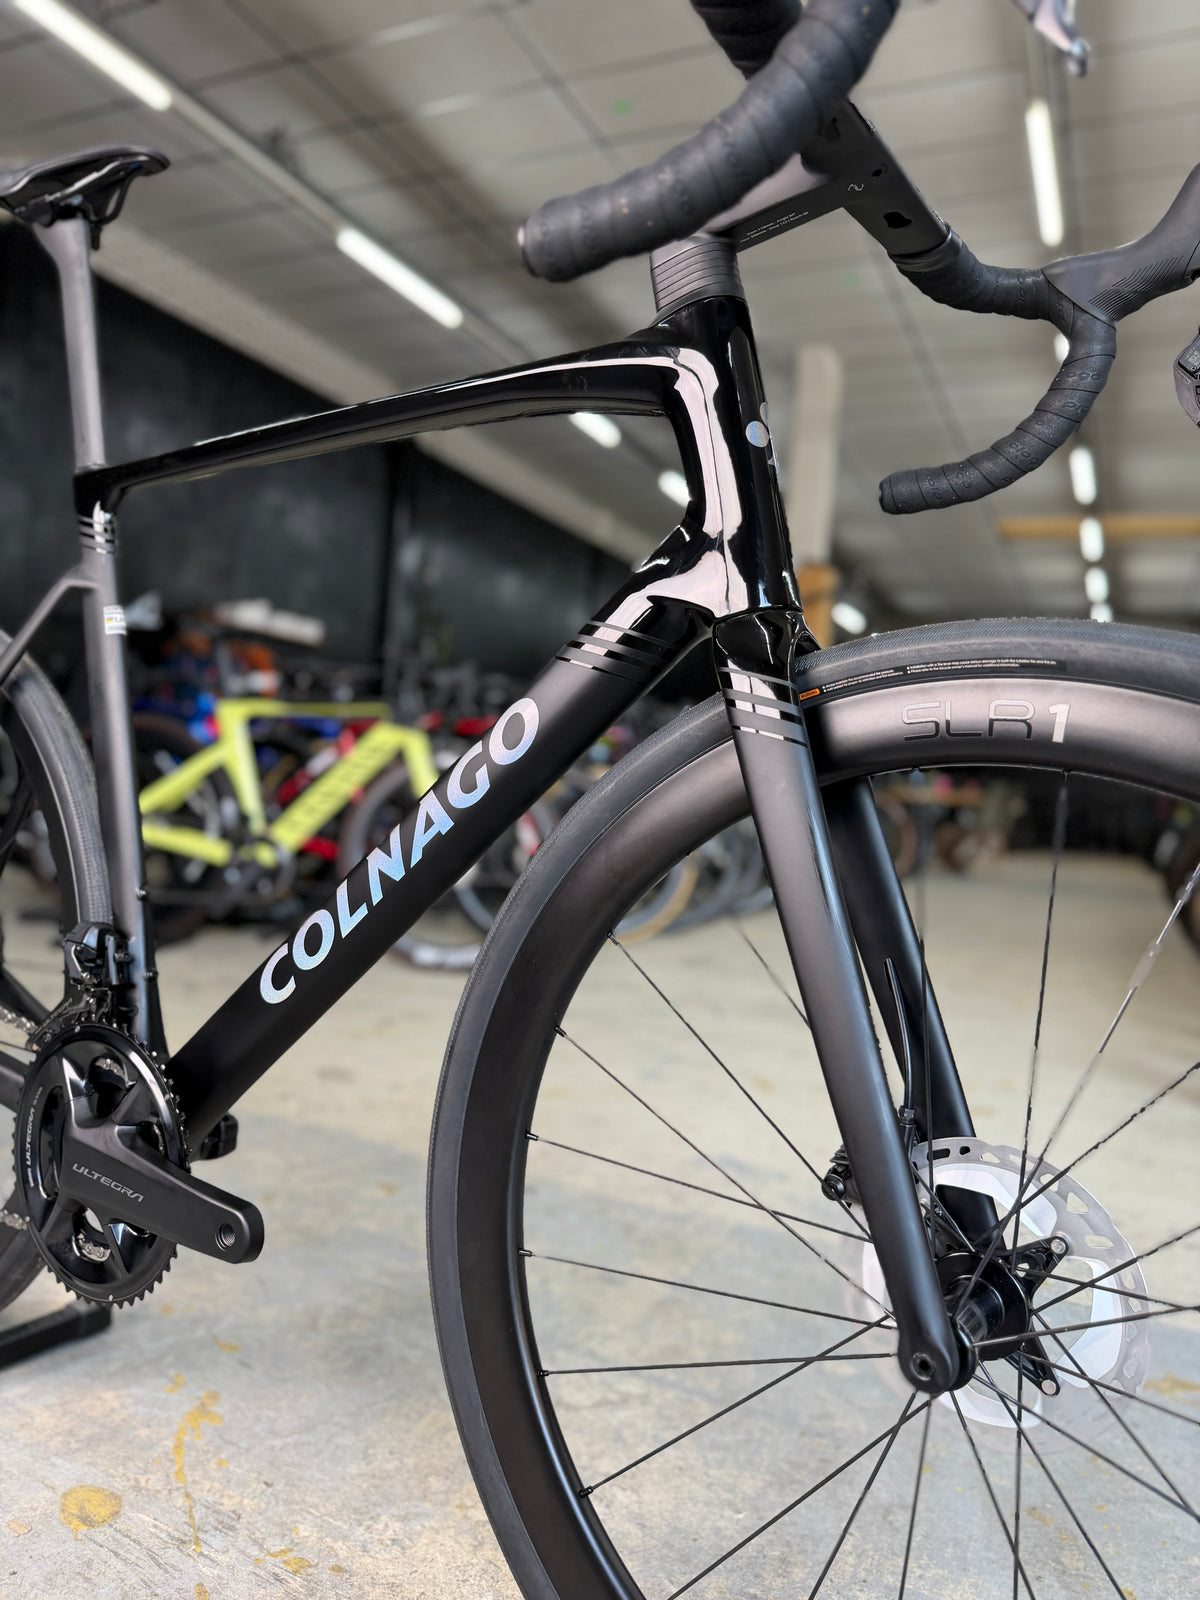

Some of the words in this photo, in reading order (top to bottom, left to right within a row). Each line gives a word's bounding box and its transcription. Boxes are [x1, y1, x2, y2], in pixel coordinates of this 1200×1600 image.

[259, 697, 540, 1005] COLNAGO
[25, 1107, 36, 1166] ULTEGRA
[72, 1163, 145, 1203] ULTEGRA
